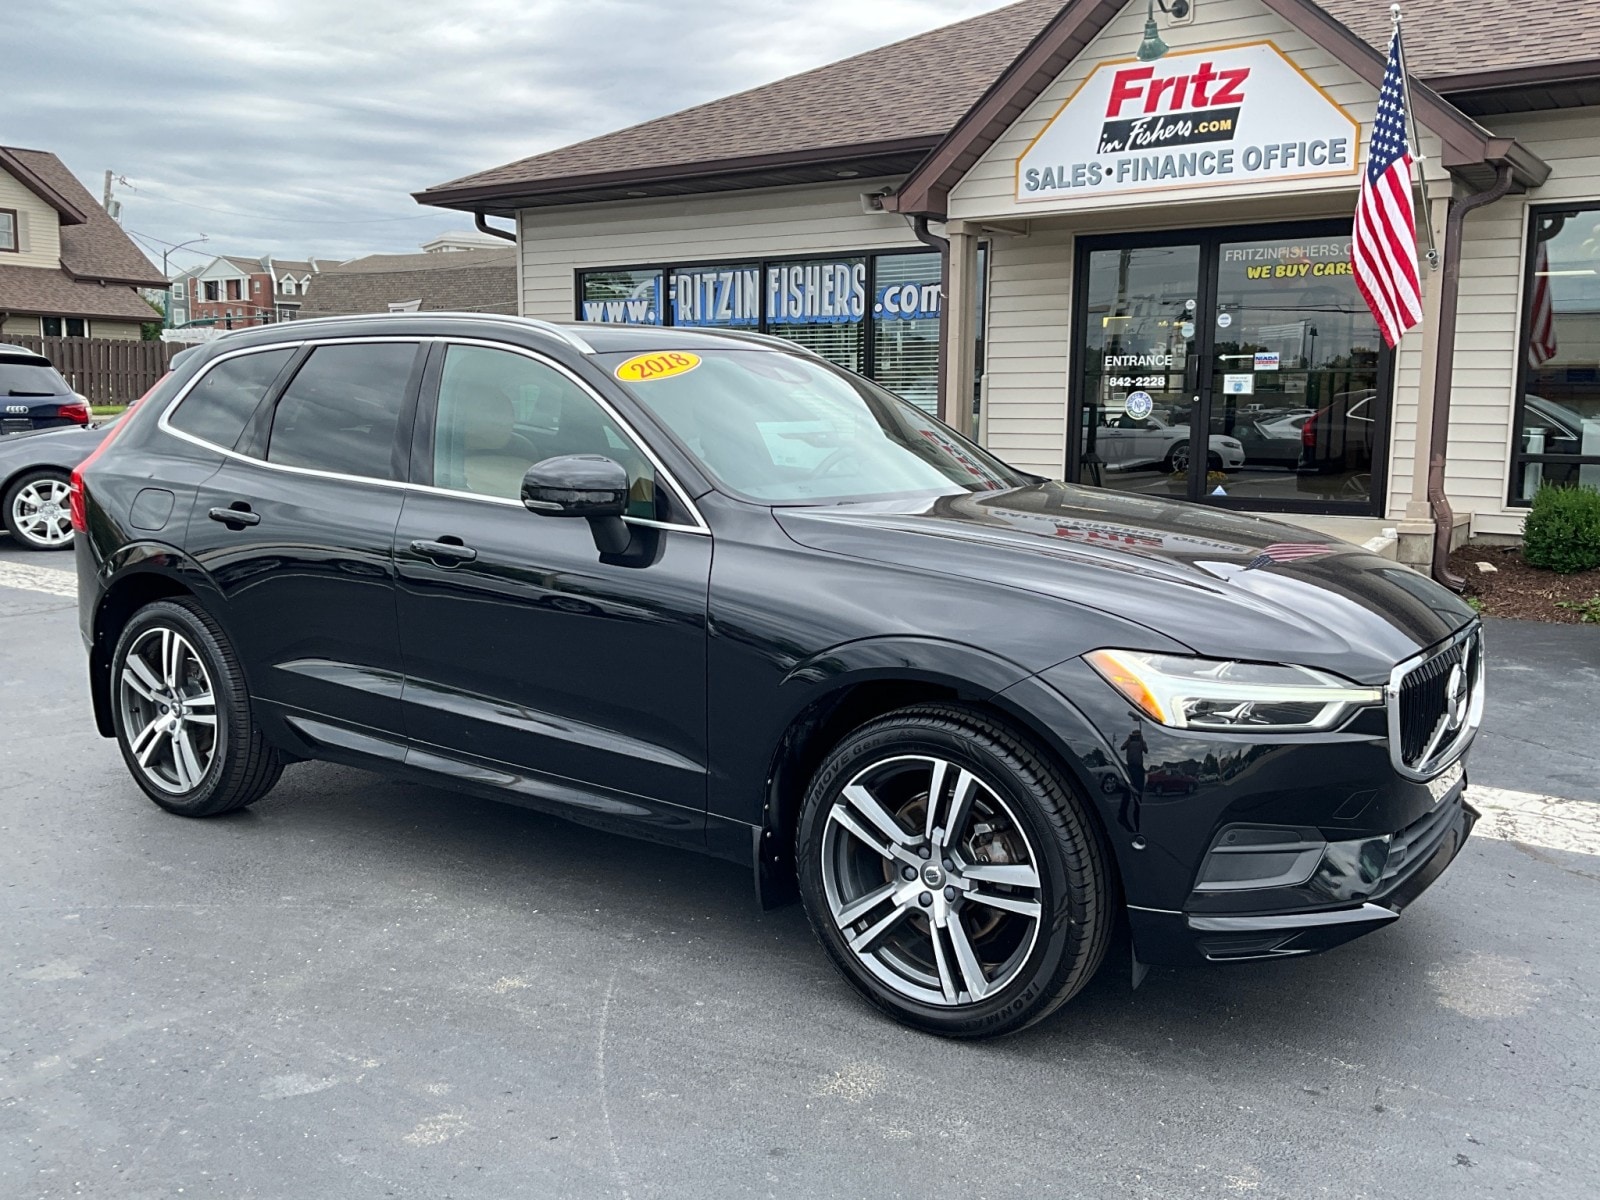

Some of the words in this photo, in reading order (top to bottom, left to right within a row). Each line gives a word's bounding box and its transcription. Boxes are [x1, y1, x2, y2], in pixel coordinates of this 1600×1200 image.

[1105, 61, 1251, 118] Fritz
[1100, 133, 1123, 154] in
[1025, 161, 1103, 192] SALES
[1116, 148, 1235, 183] FINANCE
[1242, 137, 1348, 171] OFFICE
[1247, 265, 1272, 279] WE
[1275, 263, 1310, 278] BUY
[1312, 262, 1354, 277] CARS
[583, 299, 656, 324] www.
[767, 263, 867, 319] FISHERS
[874, 284, 941, 313] .com
[631, 352, 691, 379] 2018
[1104, 354, 1174, 367] ENTRANCE
[1109, 376, 1166, 387] 842-2228
